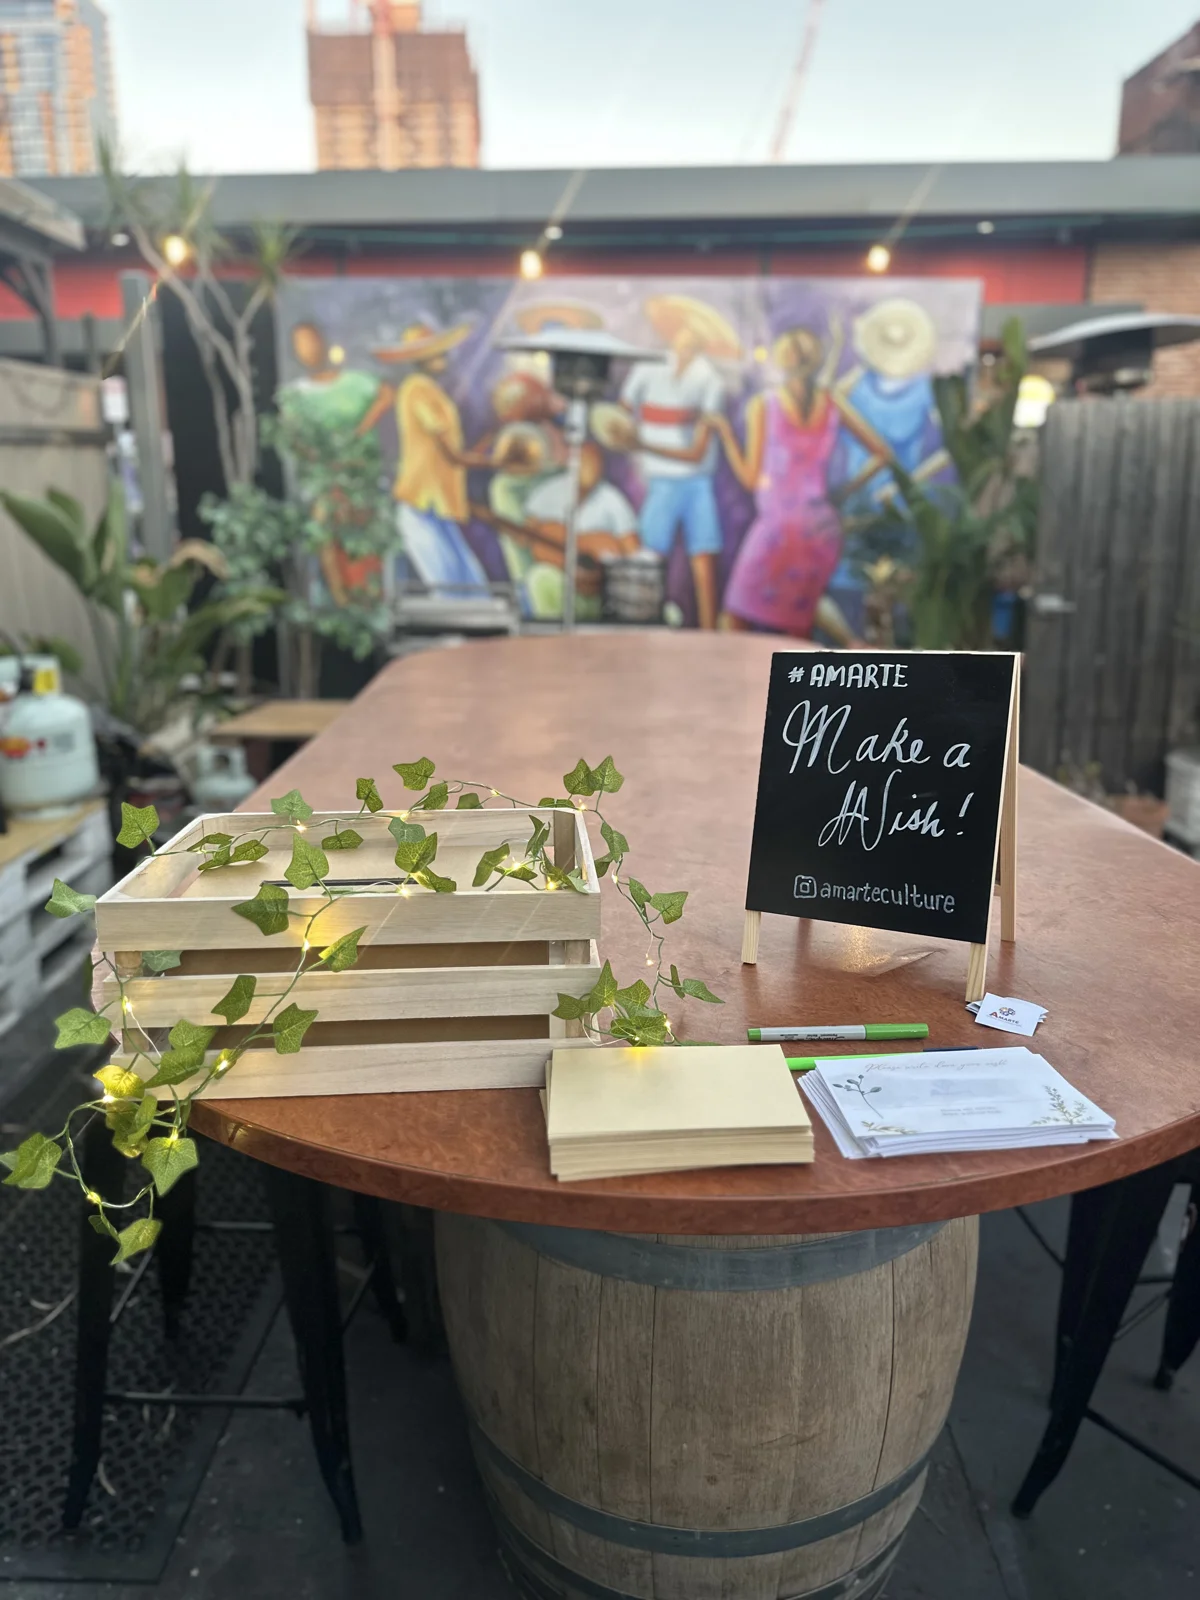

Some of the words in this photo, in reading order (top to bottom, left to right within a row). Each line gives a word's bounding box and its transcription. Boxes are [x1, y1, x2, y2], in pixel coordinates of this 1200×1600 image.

[782, 699, 931, 774] Make
[943, 743, 971, 768] a
[818, 769, 974, 851] Wish!
[820, 882, 955, 913] amarteculture
